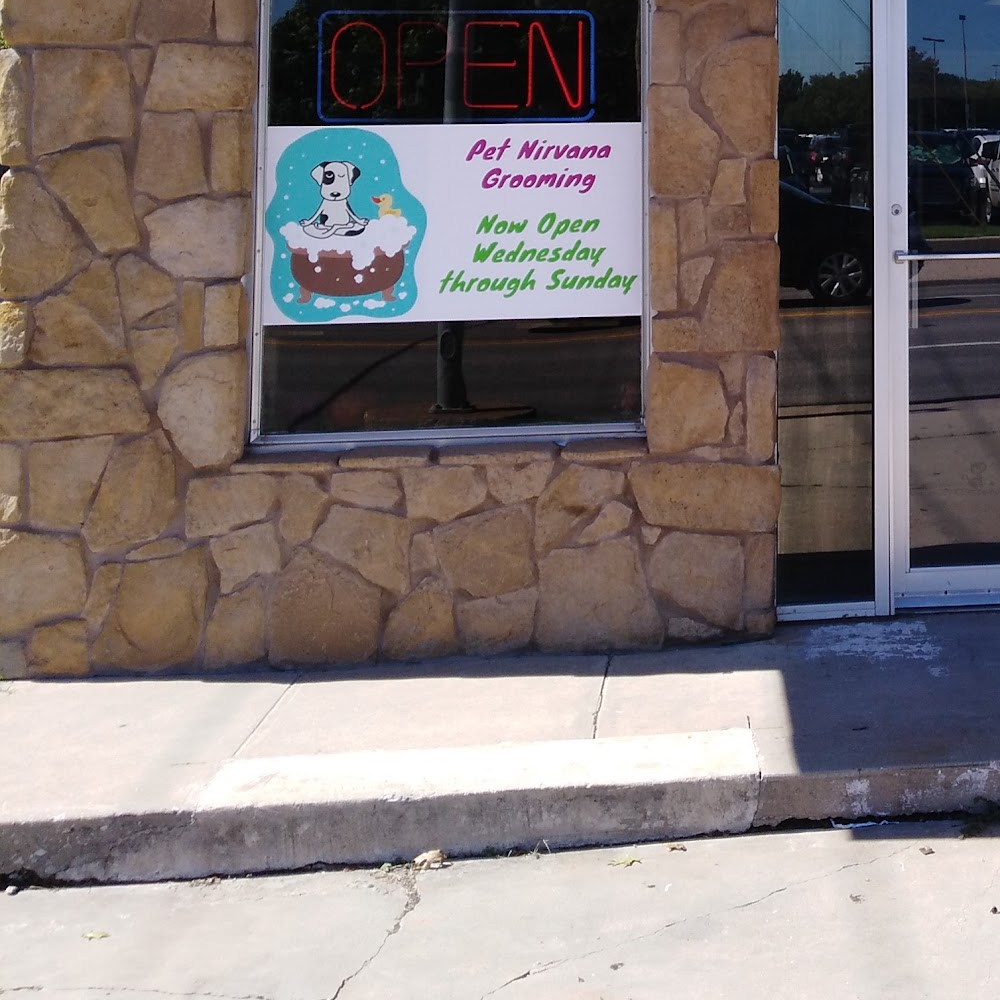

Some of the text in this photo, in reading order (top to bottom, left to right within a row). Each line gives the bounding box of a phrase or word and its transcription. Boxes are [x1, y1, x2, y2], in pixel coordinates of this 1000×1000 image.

[330, 20, 584, 111] OPEN
[465, 137, 612, 162] Pet Nirvana
[481, 167, 597, 194] Grooming
[476, 212, 600, 239] Now Open
[472, 240, 606, 267] Wednesday
[439, 267, 638, 298] through Sunday
